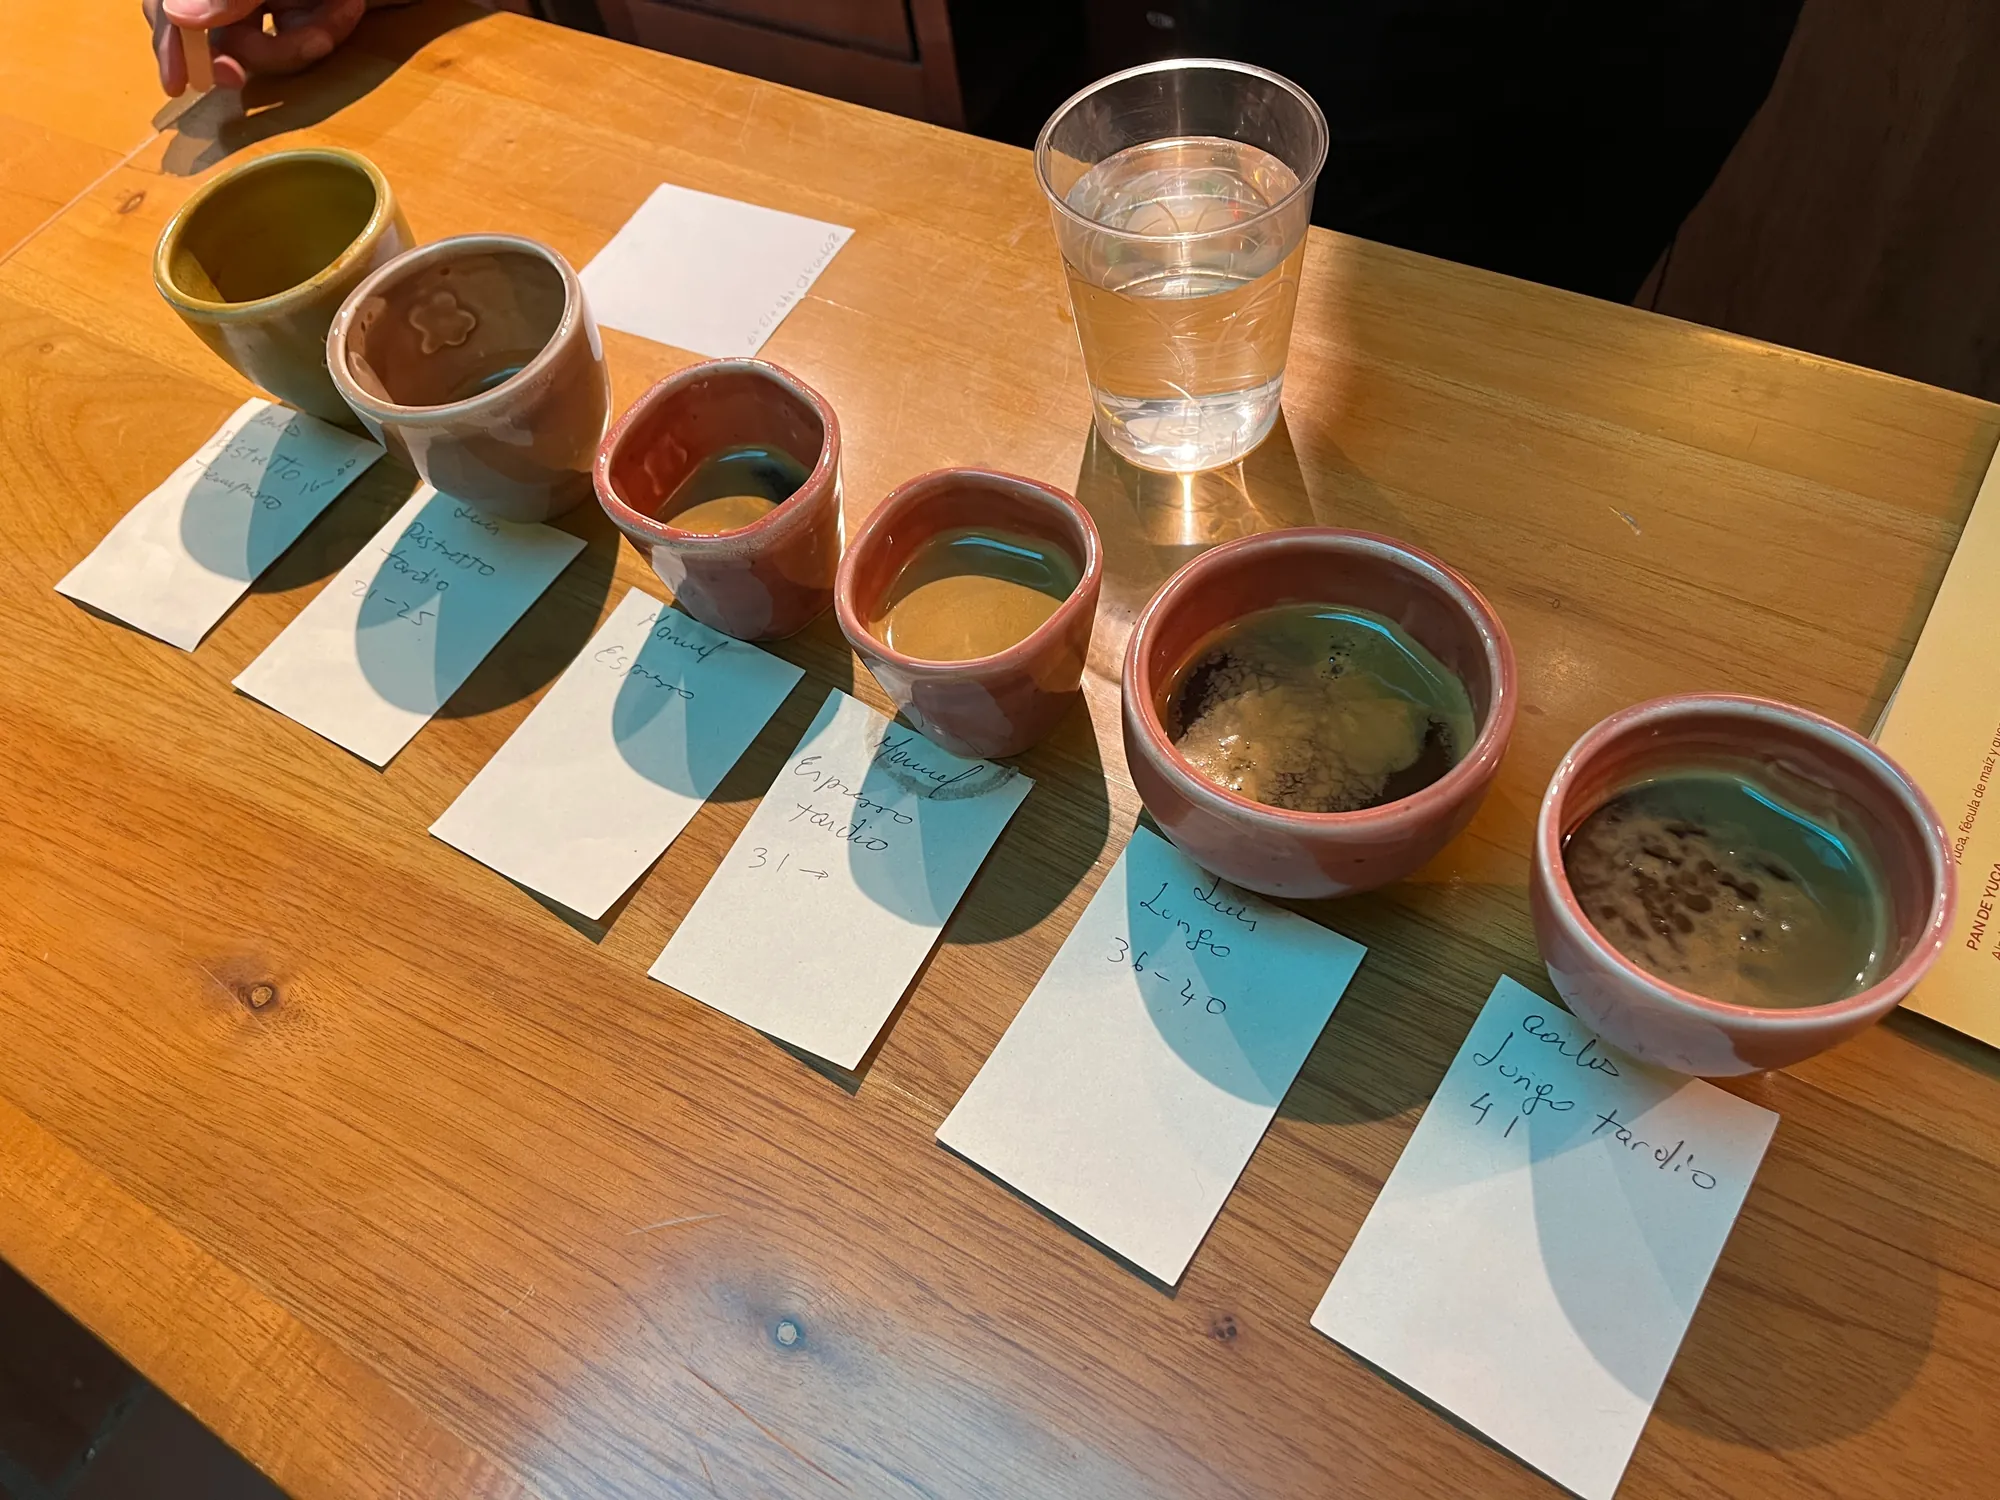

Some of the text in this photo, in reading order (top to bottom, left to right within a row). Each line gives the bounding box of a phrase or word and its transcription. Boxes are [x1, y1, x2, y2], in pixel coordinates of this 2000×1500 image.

[874, 736, 984, 799] Manuel
[1958, 800, 1981, 834] fécula
[1972, 783, 1986, 799] de
[1980, 756, 1996, 783] maíz
[1194, 877, 1257, 931] Luis
[1966, 920, 1986, 951] PAN
[1976, 900, 1993, 921] DE
[1470, 1092, 1518, 1138] 41
